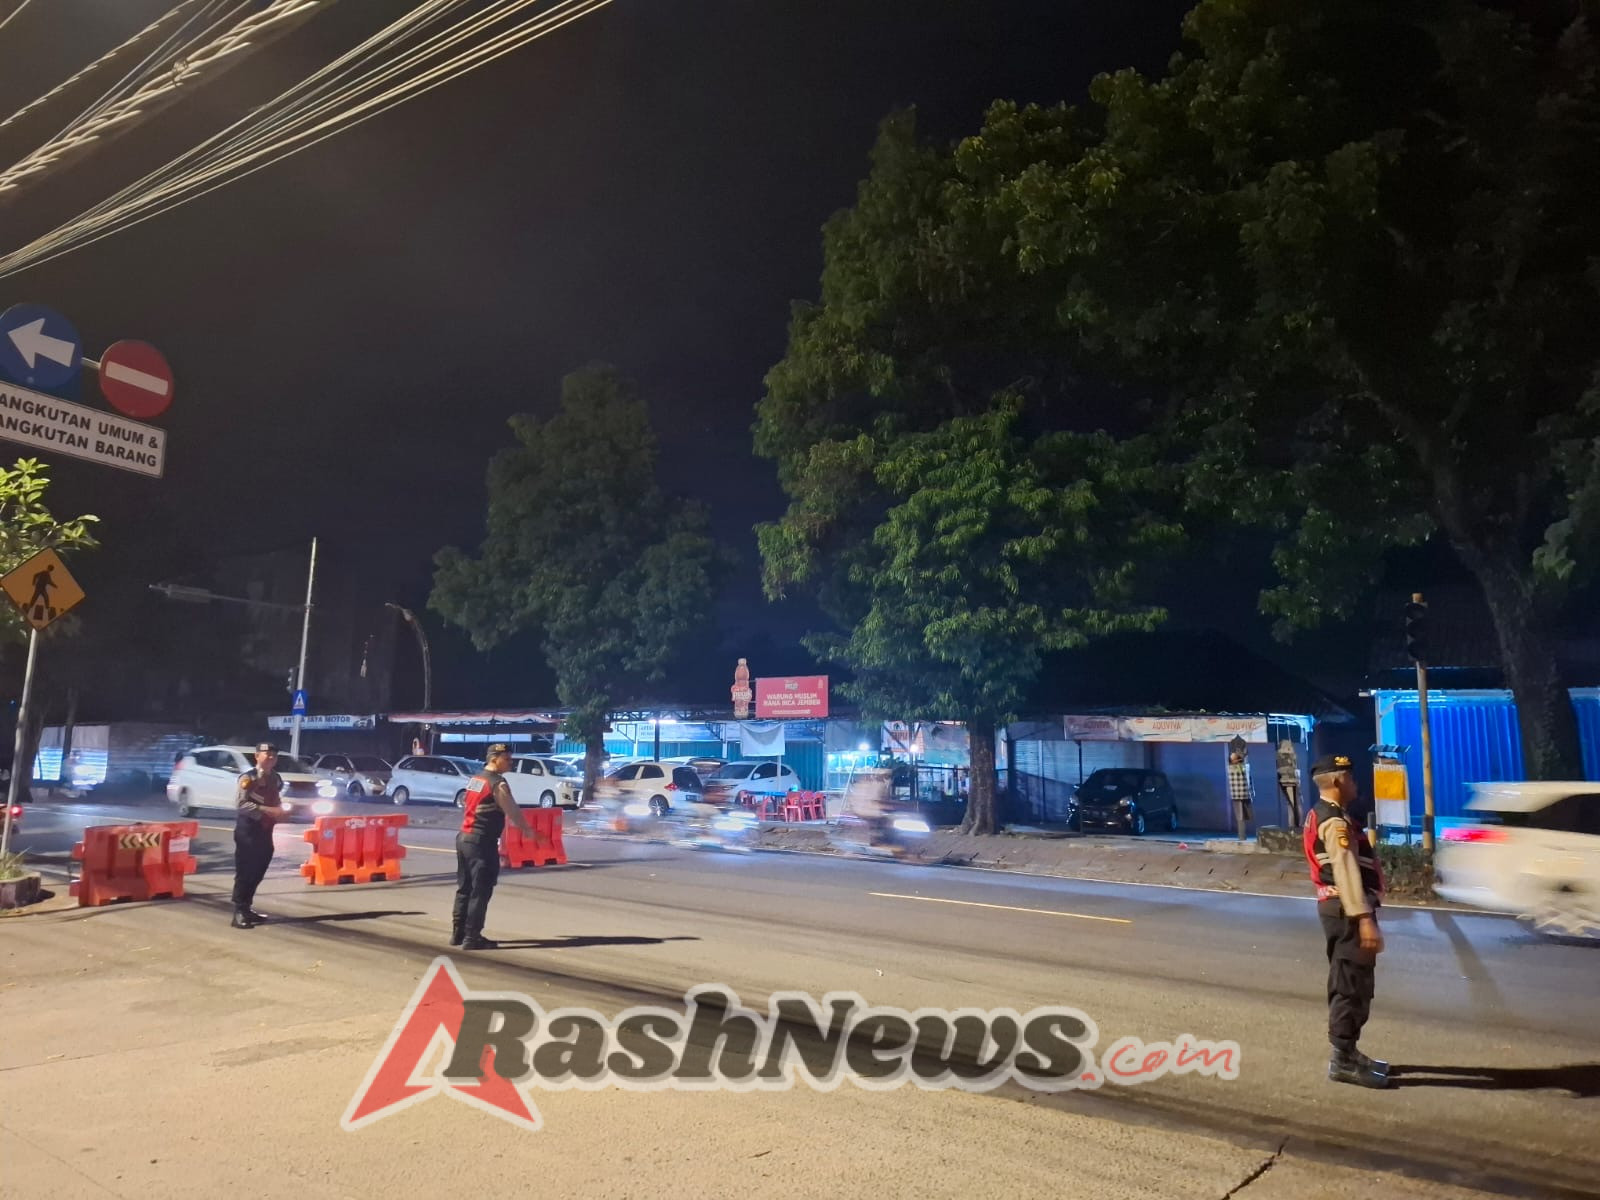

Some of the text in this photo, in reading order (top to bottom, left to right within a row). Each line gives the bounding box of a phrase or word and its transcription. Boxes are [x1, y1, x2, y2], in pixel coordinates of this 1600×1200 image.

[0, 393, 158, 448] ANGKUTAN UMUM &
[95, 440, 157, 467] BARANG
[325, 715, 351, 723] MOTOR
